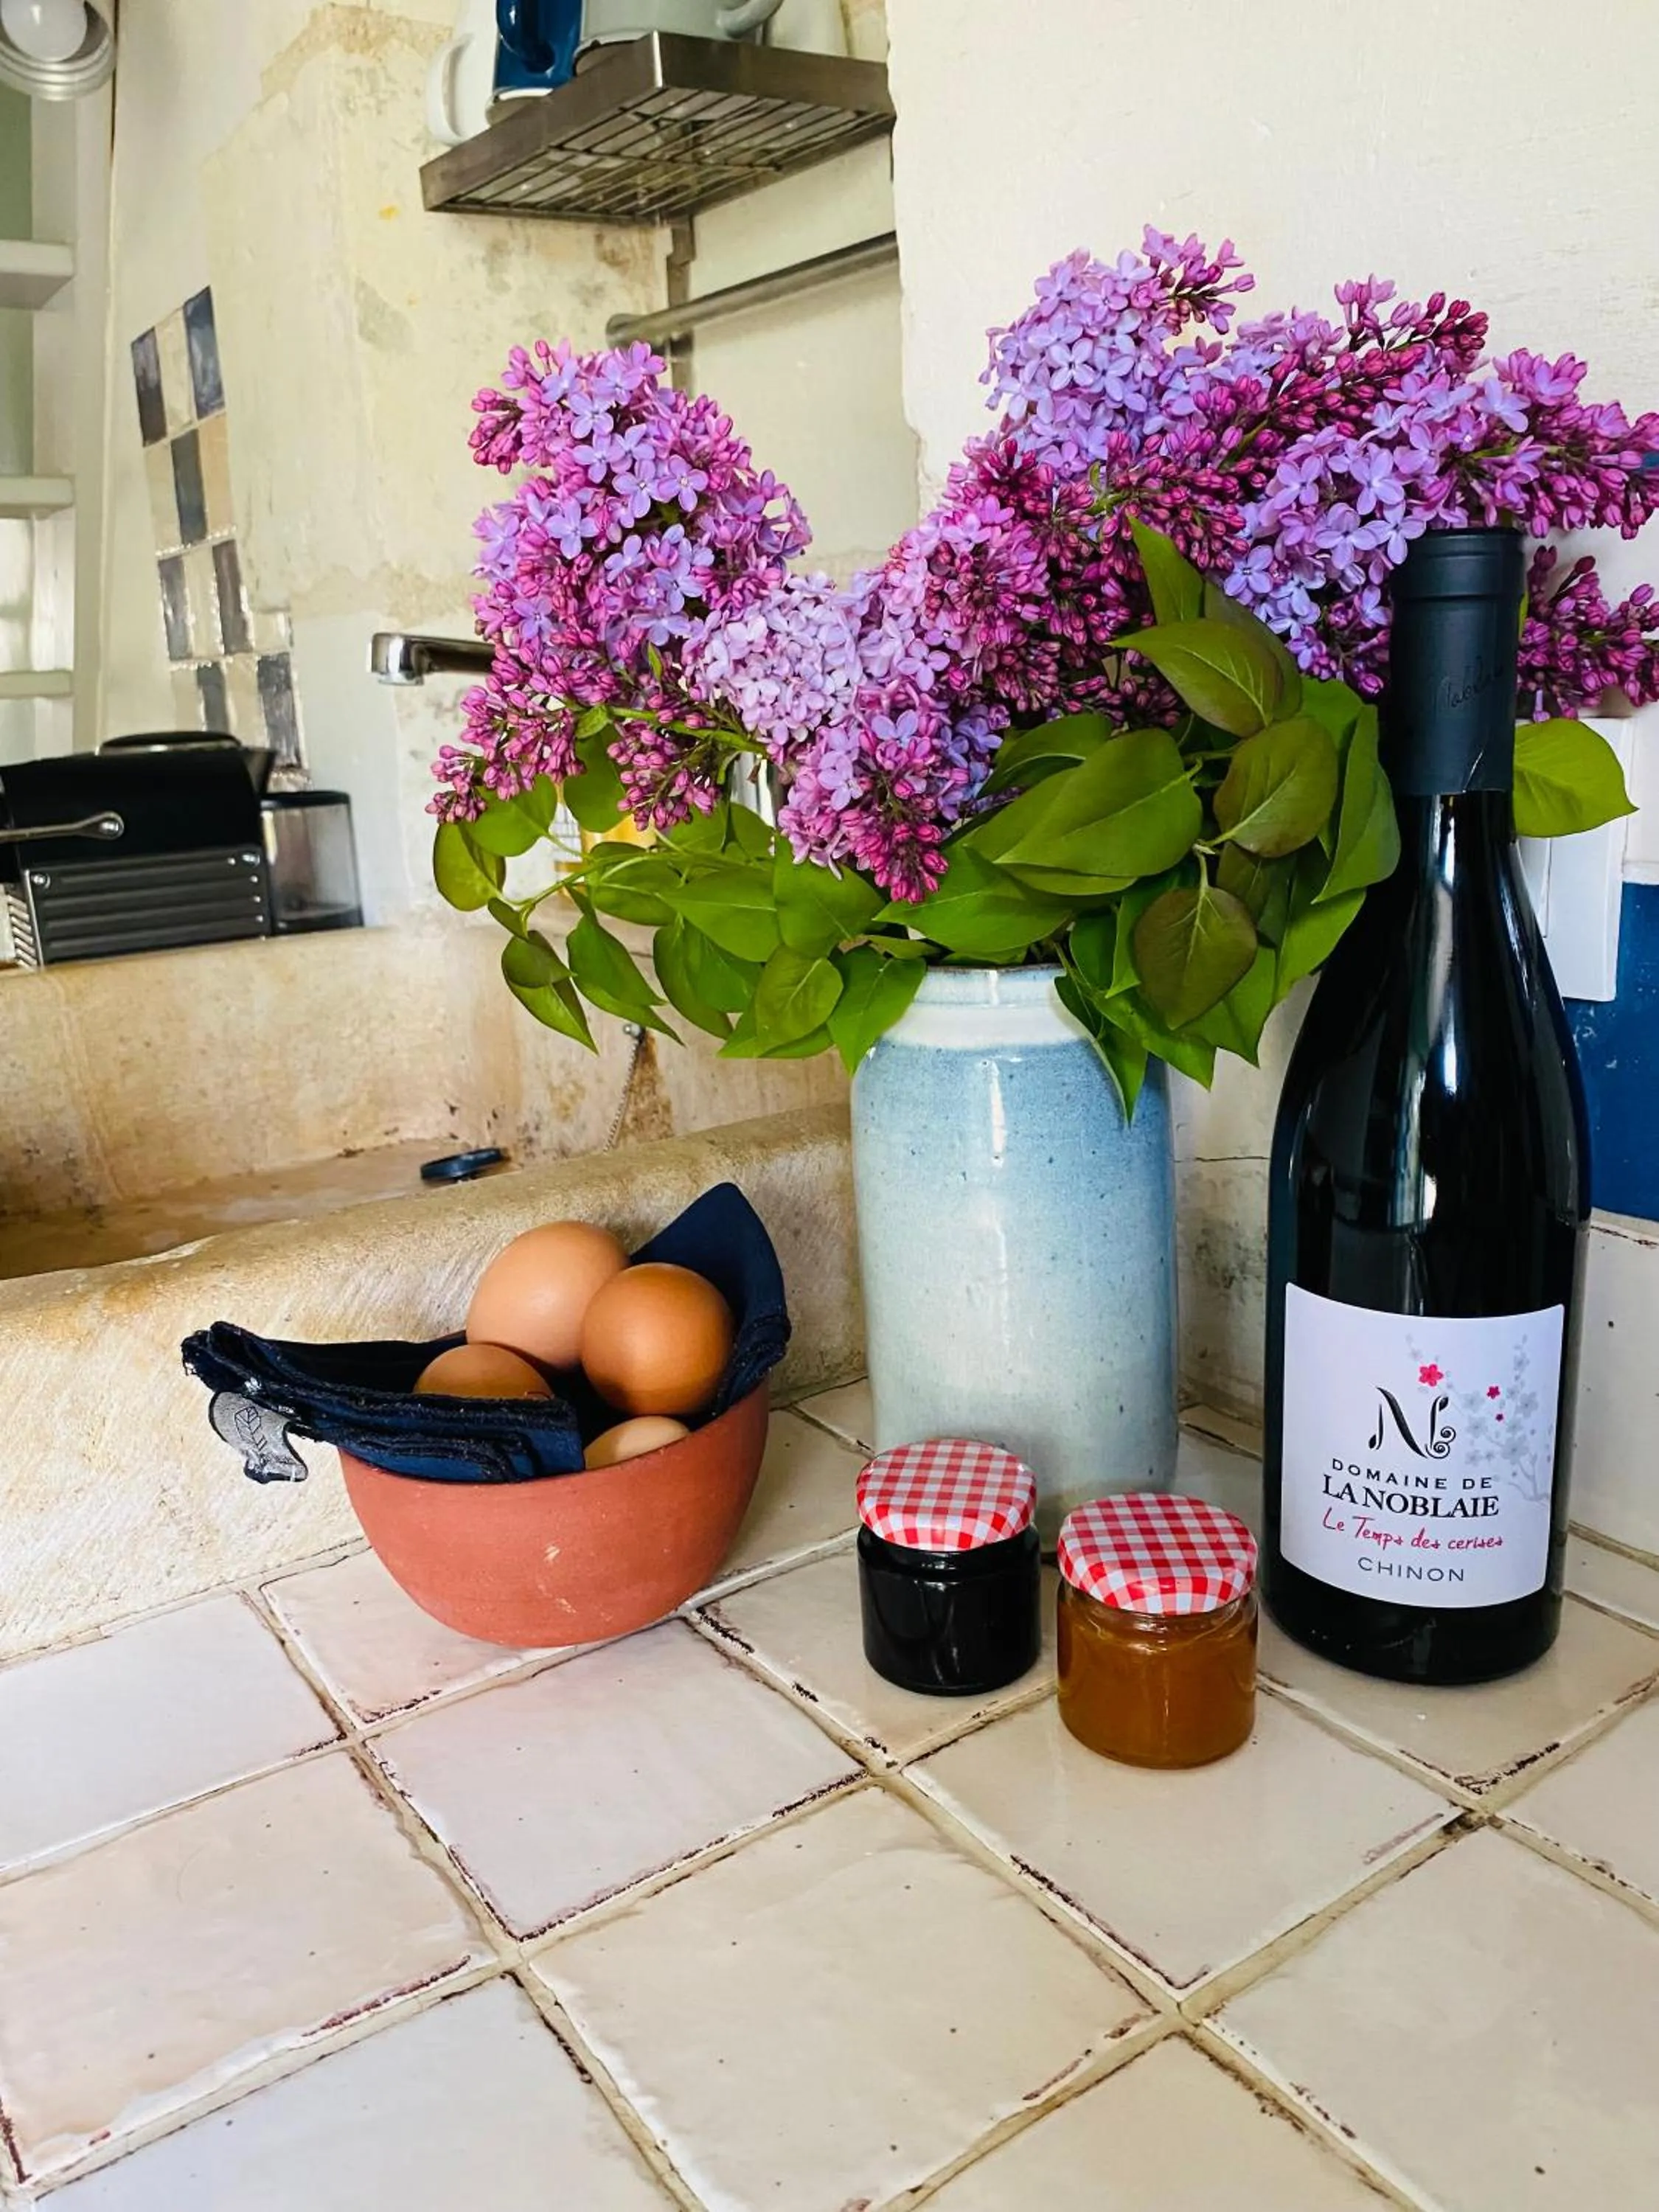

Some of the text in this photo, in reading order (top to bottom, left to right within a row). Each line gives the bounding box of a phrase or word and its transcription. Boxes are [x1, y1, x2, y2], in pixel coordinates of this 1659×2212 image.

[1332, 1458, 1492, 1489] DOMAINE DE
[1322, 1507, 1503, 1551] Le Temps des cerises
[1357, 1557, 1464, 1582] CHINON
